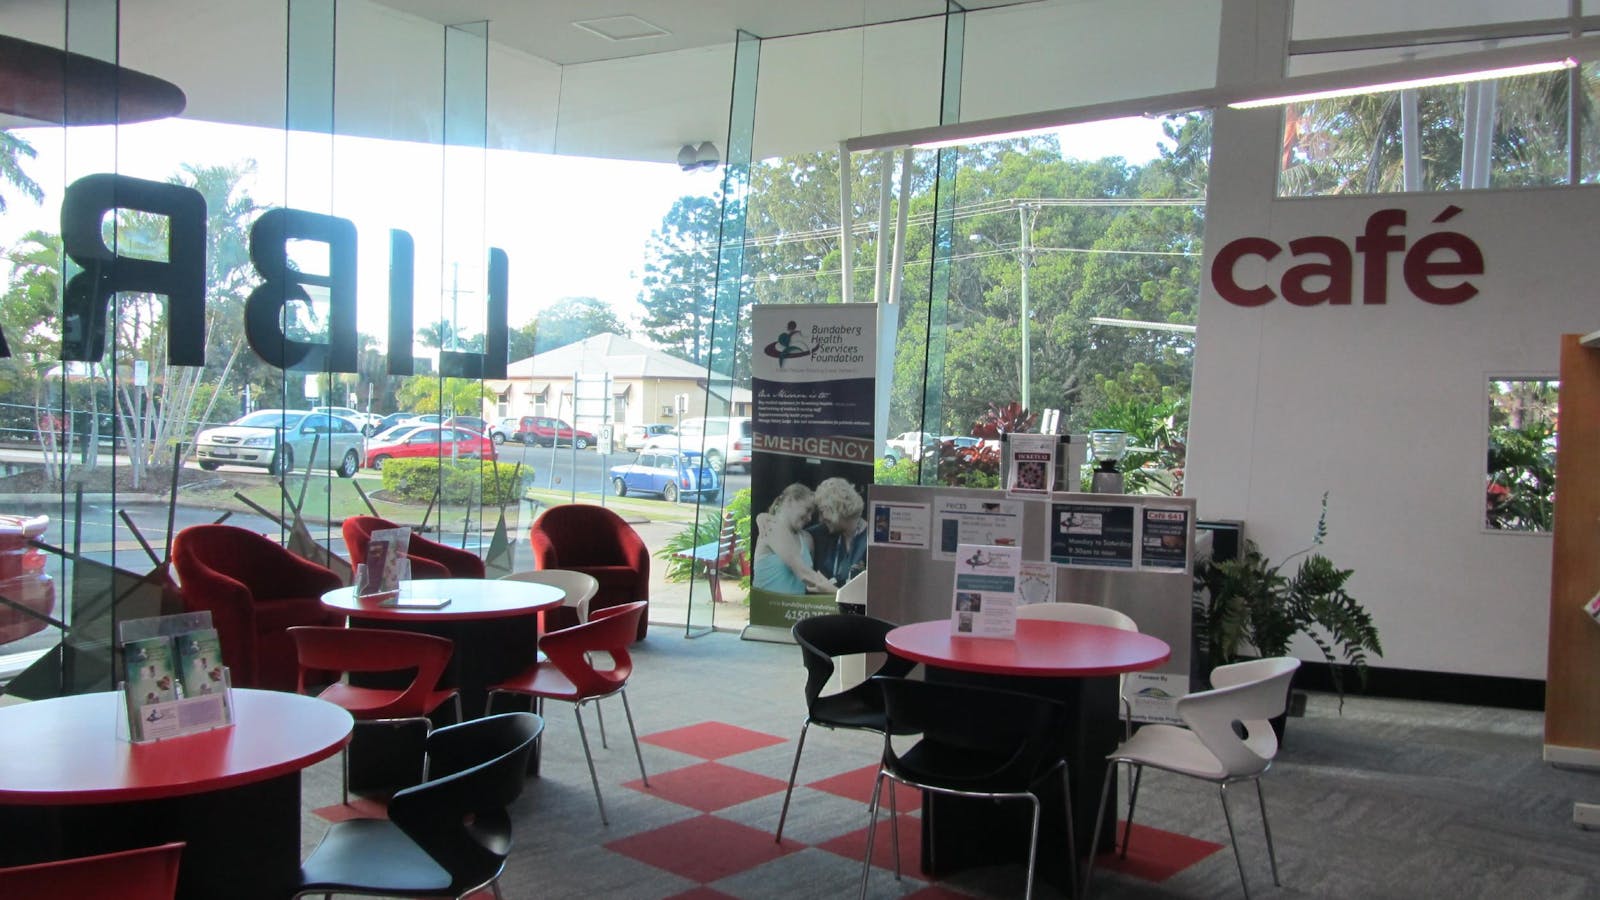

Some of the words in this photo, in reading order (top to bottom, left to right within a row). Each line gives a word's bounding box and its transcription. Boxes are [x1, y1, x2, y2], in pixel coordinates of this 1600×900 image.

[1211, 205, 1484, 306] café
[811, 325, 862, 336] Bundaberg
[810, 334, 843, 344] Health
[819, 344, 859, 353] Services
[810, 354, 864, 363] Foundation
[753, 432, 869, 458] EMERGENCY
[1068, 538, 1094, 547] Monday
